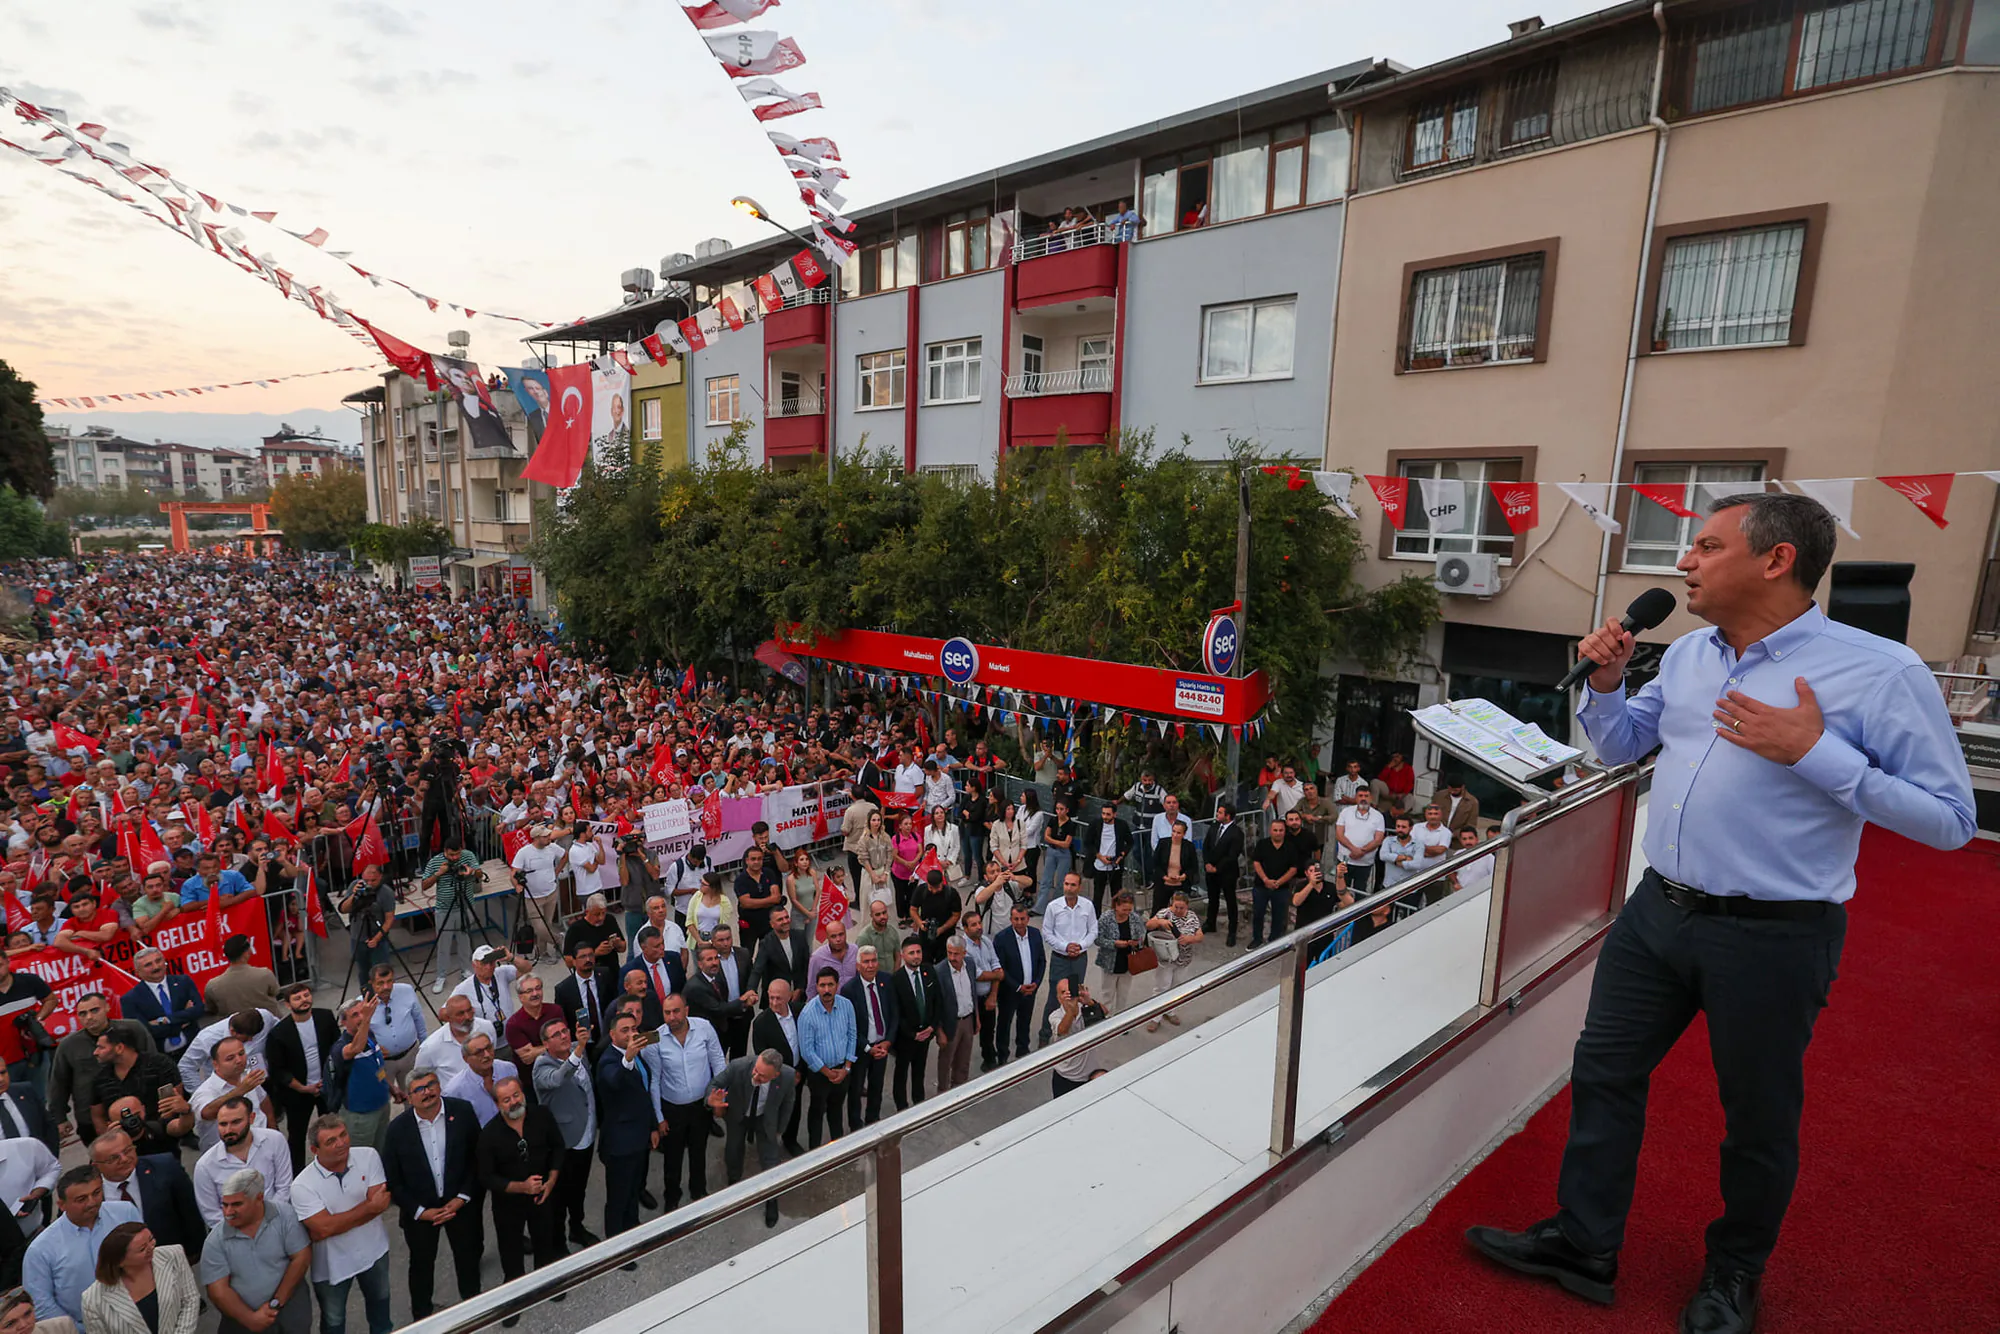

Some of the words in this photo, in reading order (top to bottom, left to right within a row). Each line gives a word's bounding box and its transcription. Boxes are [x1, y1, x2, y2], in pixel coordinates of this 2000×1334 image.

[738, 34, 752, 67] CHP
[1429, 504, 1457, 518] CHP
[1507, 505, 1531, 517] CHP
[944, 651, 971, 669] seç
[989, 662, 1010, 673] Marketi
[792, 804, 818, 817] HATA
[822, 902, 844, 925] CHP
